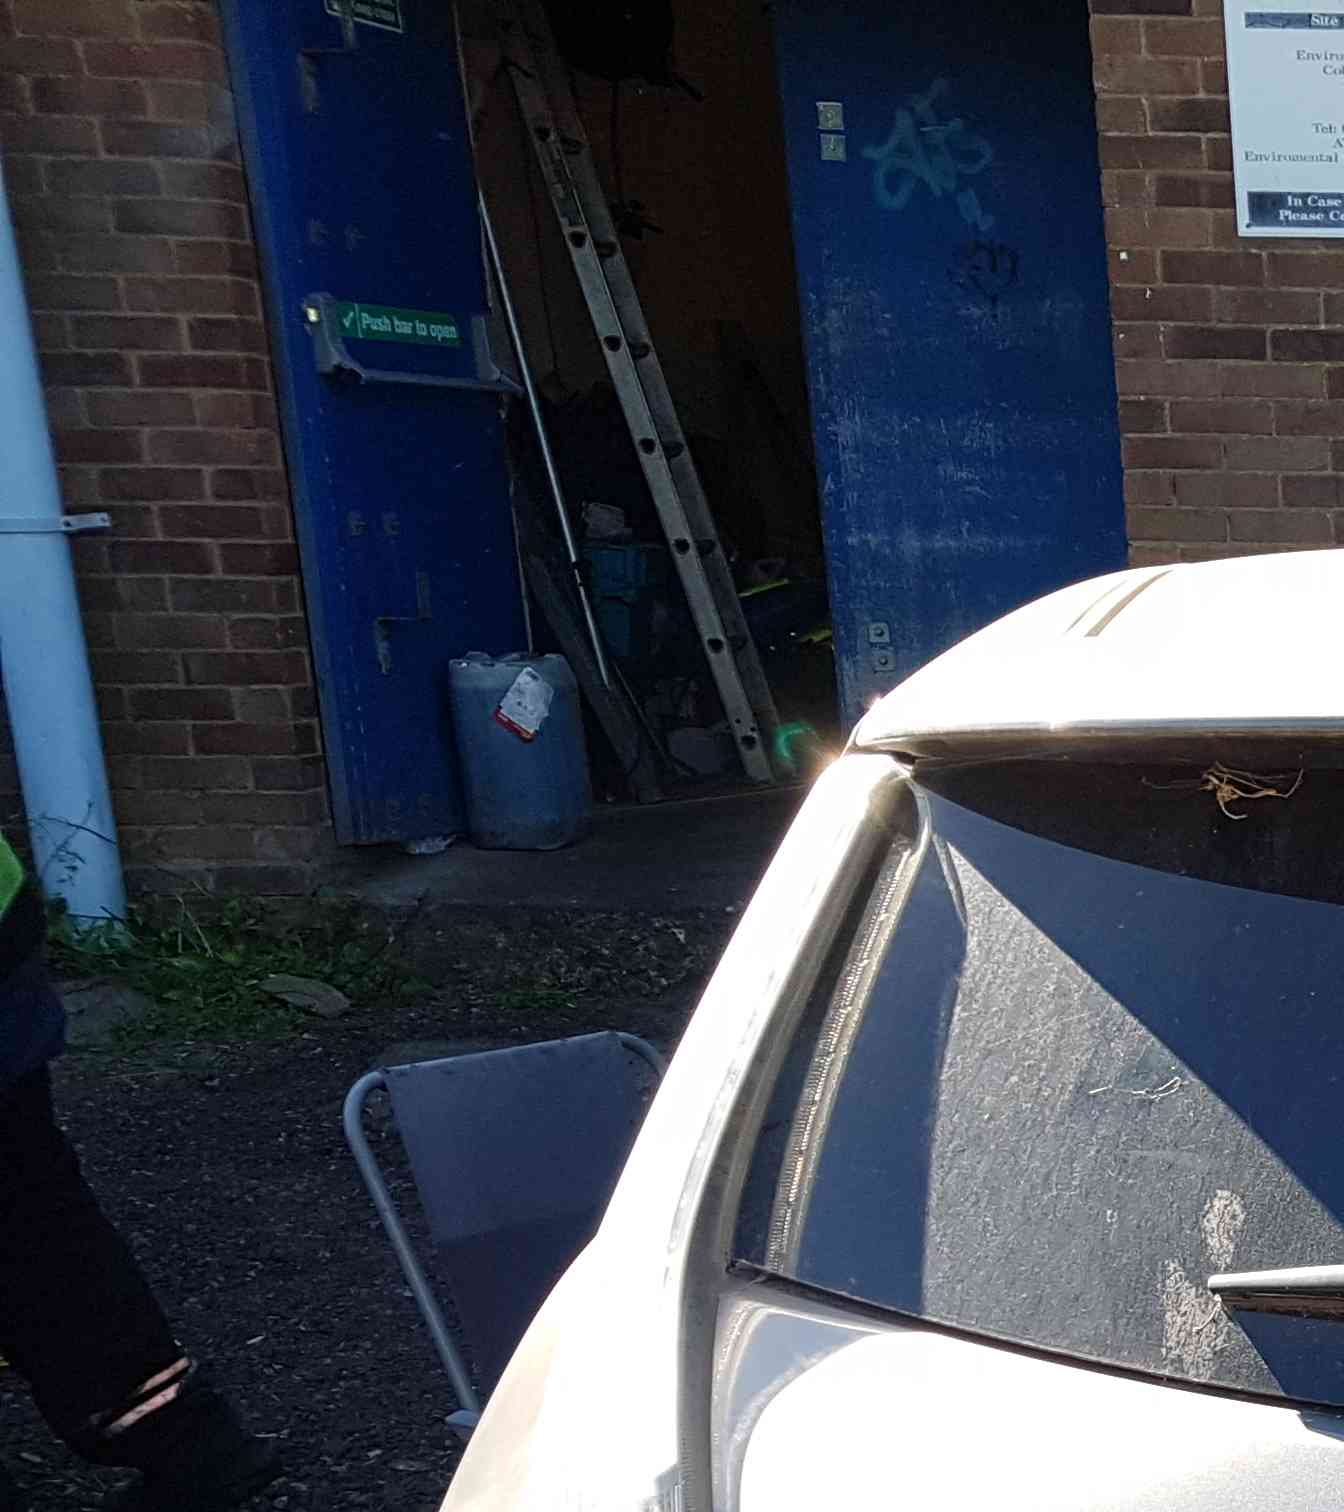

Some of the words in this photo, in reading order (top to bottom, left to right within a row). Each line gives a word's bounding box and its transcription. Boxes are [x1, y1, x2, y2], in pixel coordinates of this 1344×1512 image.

[1311, 14, 1339, 27] Site
[1312, 122, 1337, 135] Tel:
[1287, 195, 1303, 207] In
[1307, 195, 1342, 207] Case
[1278, 209, 1325, 221] Please
[360, 312, 392, 333] Push
[392, 315, 413, 335] bar
[415, 319, 428, 336] to
[429, 323, 457, 342] open
